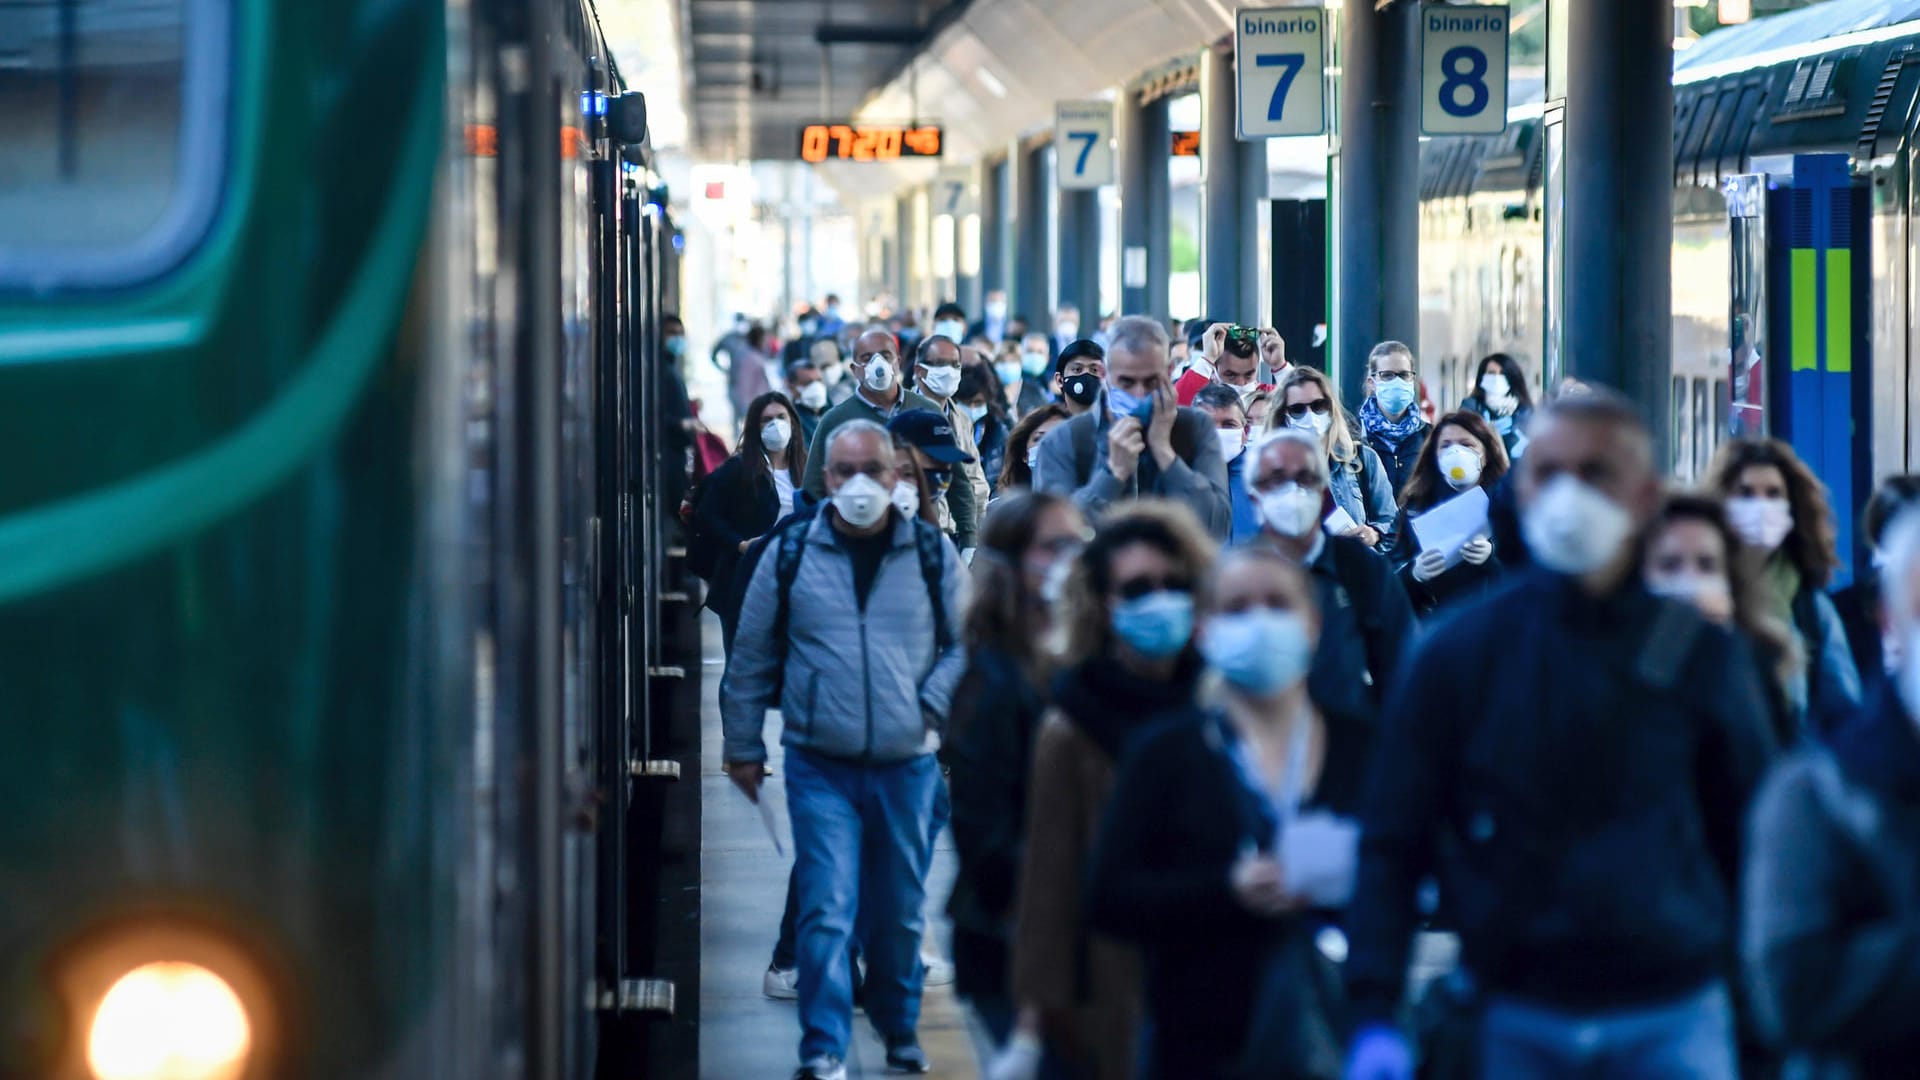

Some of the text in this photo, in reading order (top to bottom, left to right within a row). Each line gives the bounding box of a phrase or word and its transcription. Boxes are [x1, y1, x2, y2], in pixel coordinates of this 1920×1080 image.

[1245, 17, 1317, 35] binario
[1430, 14, 1502, 33] binario
[1256, 53, 1305, 121] 7
[1438, 46, 1489, 117] 8
[1068, 132, 1099, 176] 7
